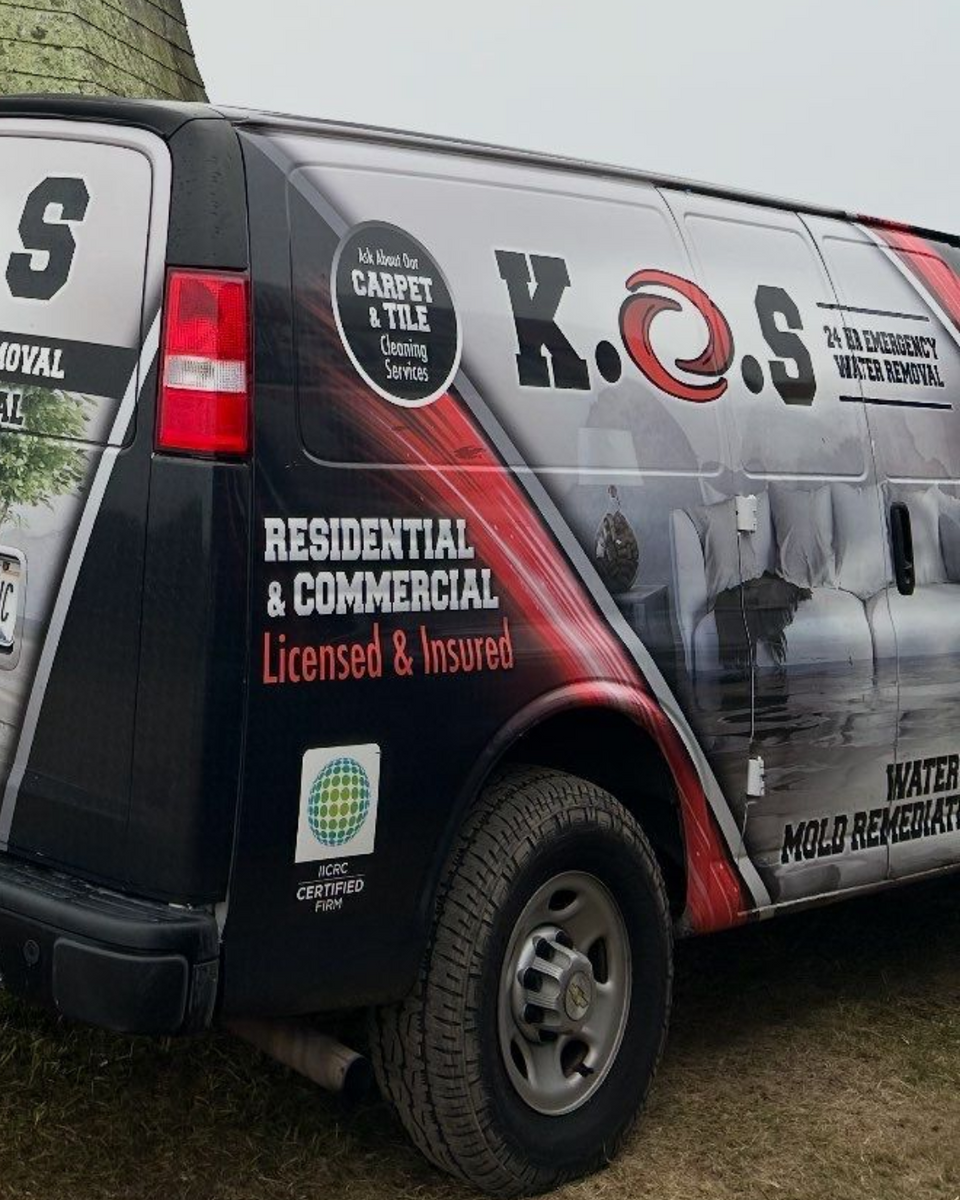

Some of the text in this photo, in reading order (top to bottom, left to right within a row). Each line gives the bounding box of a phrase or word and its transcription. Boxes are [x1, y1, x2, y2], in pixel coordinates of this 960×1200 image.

[359, 247, 419, 269] Ask About Our
[352, 269, 433, 303] CARPET
[369, 302, 431, 332] & TILE
[380, 334, 428, 363] Cleaning
[823, 325, 938, 360] 24 HR EMERGENCY
[385, 359, 429, 381] Services
[833, 354, 945, 387] WATER REMOVAL
[264, 517, 475, 562] RESIDENTIAL
[267, 569, 499, 617] & COMMERCIAL
[263, 617, 514, 685] Licensed & Insured
[886, 754, 959, 801] WATER
[781, 815, 848, 864] MOLD
[318, 862, 349, 878] IICRC
[296, 879, 364, 901] CERTIFIED
[315, 898, 343, 912] FIRM
